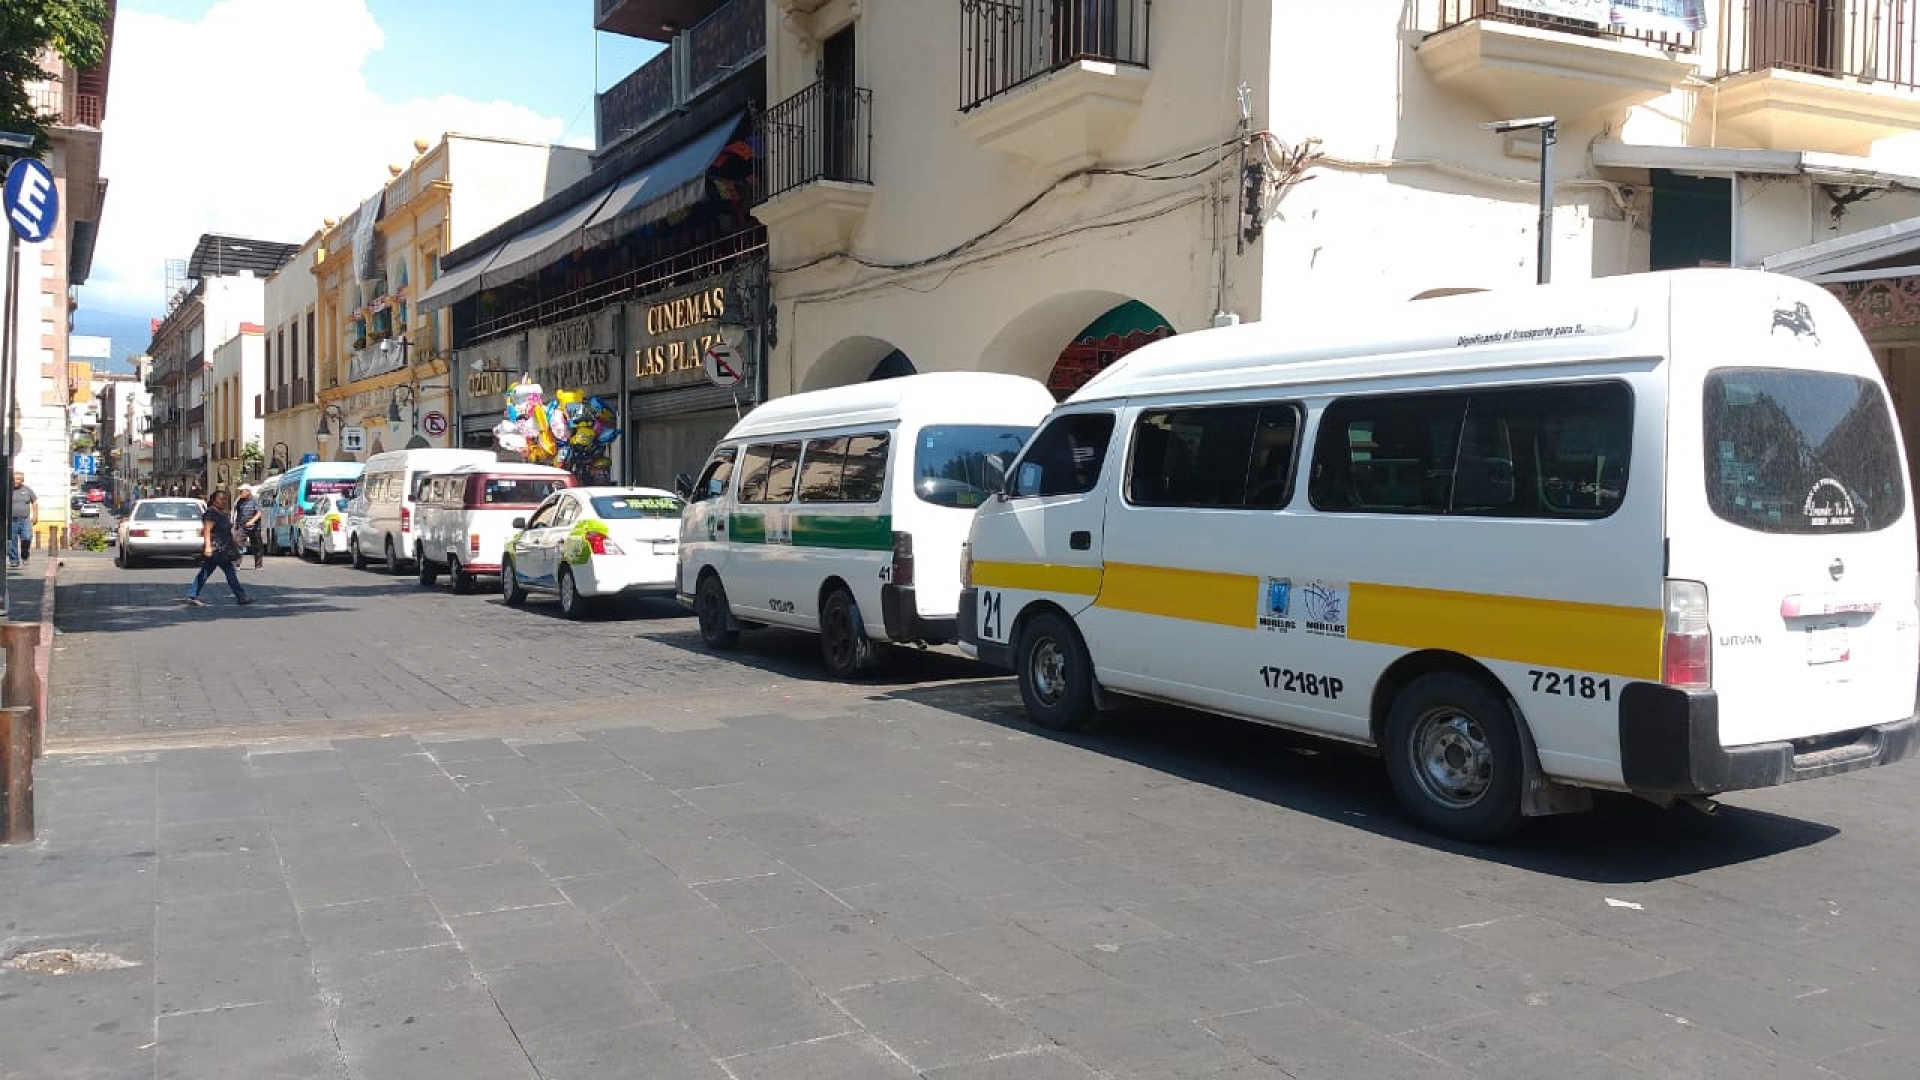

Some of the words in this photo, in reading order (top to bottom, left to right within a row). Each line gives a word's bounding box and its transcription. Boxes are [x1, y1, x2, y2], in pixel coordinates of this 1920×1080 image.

[647, 287, 725, 336] CINEMAS
[636, 345, 665, 378] LAS
[878, 566, 891, 581] 41
[983, 590, 1002, 640] 21
[1259, 617, 1297, 630] MORELOS
[1306, 620, 1346, 634] MORELOS
[1719, 634, 1762, 647] URVAN
[1259, 665, 1344, 700] 172181P
[1528, 669, 1612, 702] 72181
